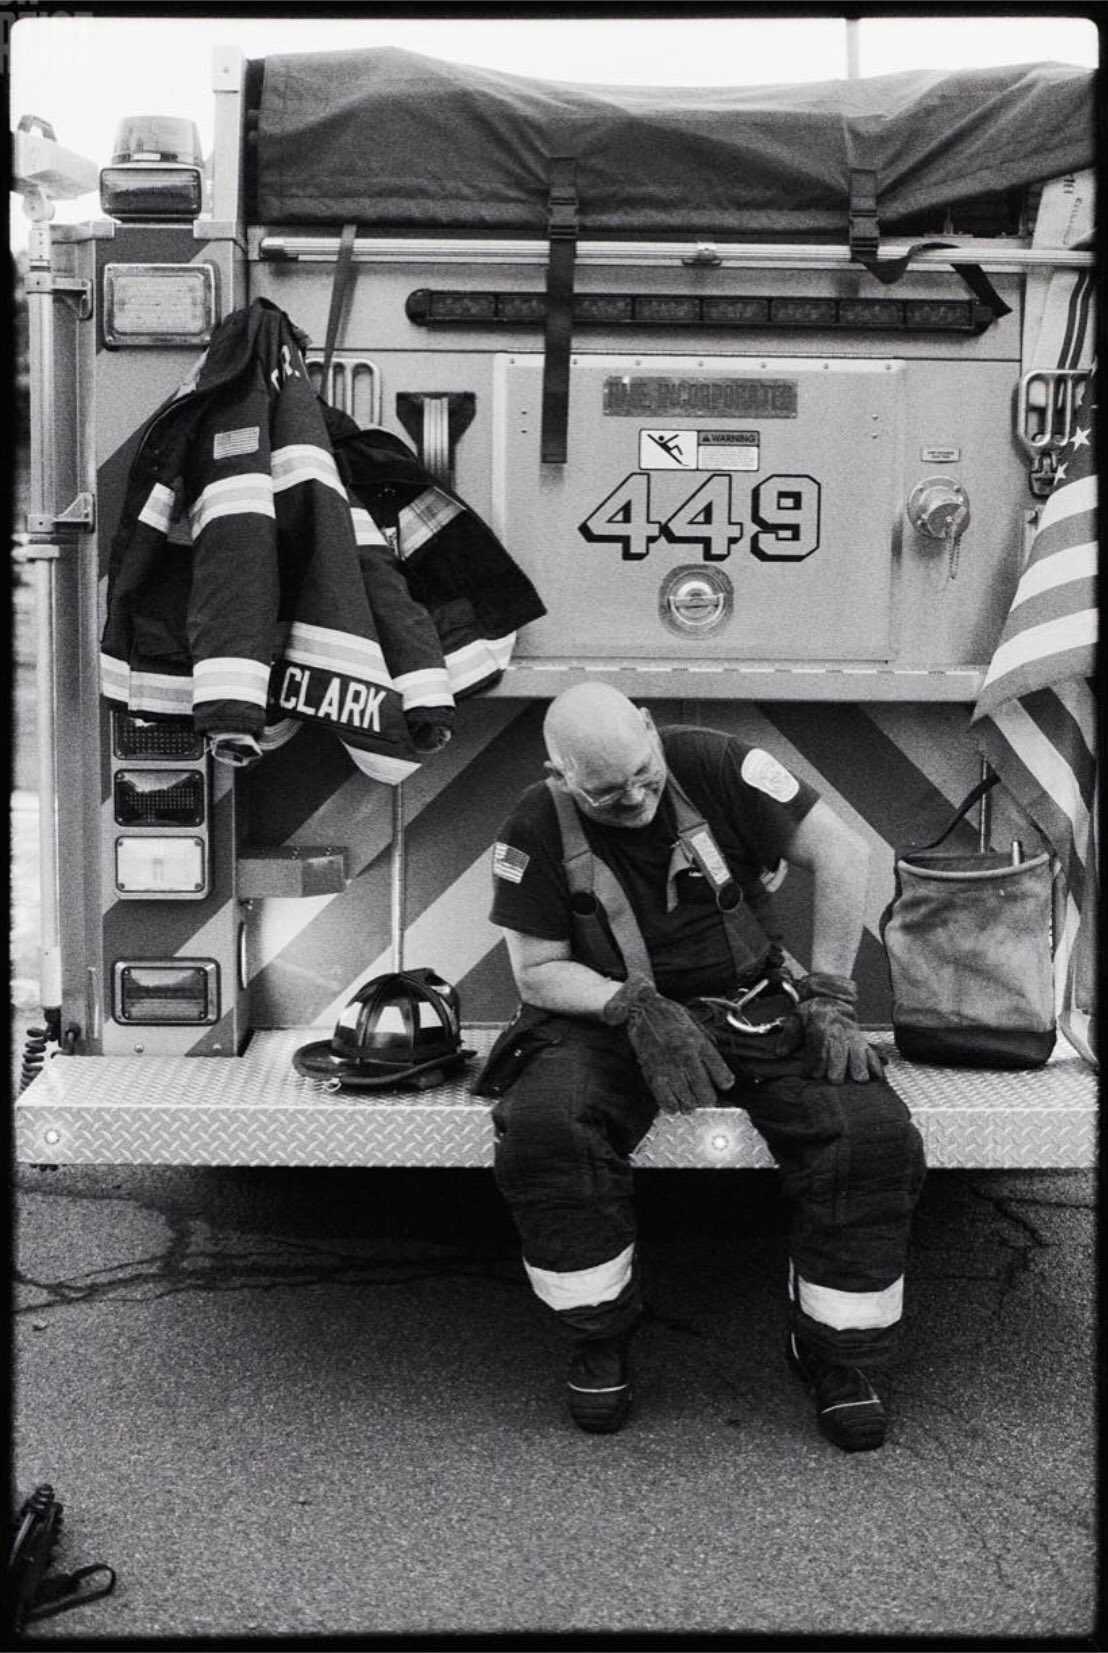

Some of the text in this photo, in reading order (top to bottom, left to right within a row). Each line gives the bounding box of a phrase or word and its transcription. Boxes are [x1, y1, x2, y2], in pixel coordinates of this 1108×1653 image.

[711, 434, 756, 443] WARNING
[578, 472, 821, 562] 449
[280, 666, 387, 732] CLARK
